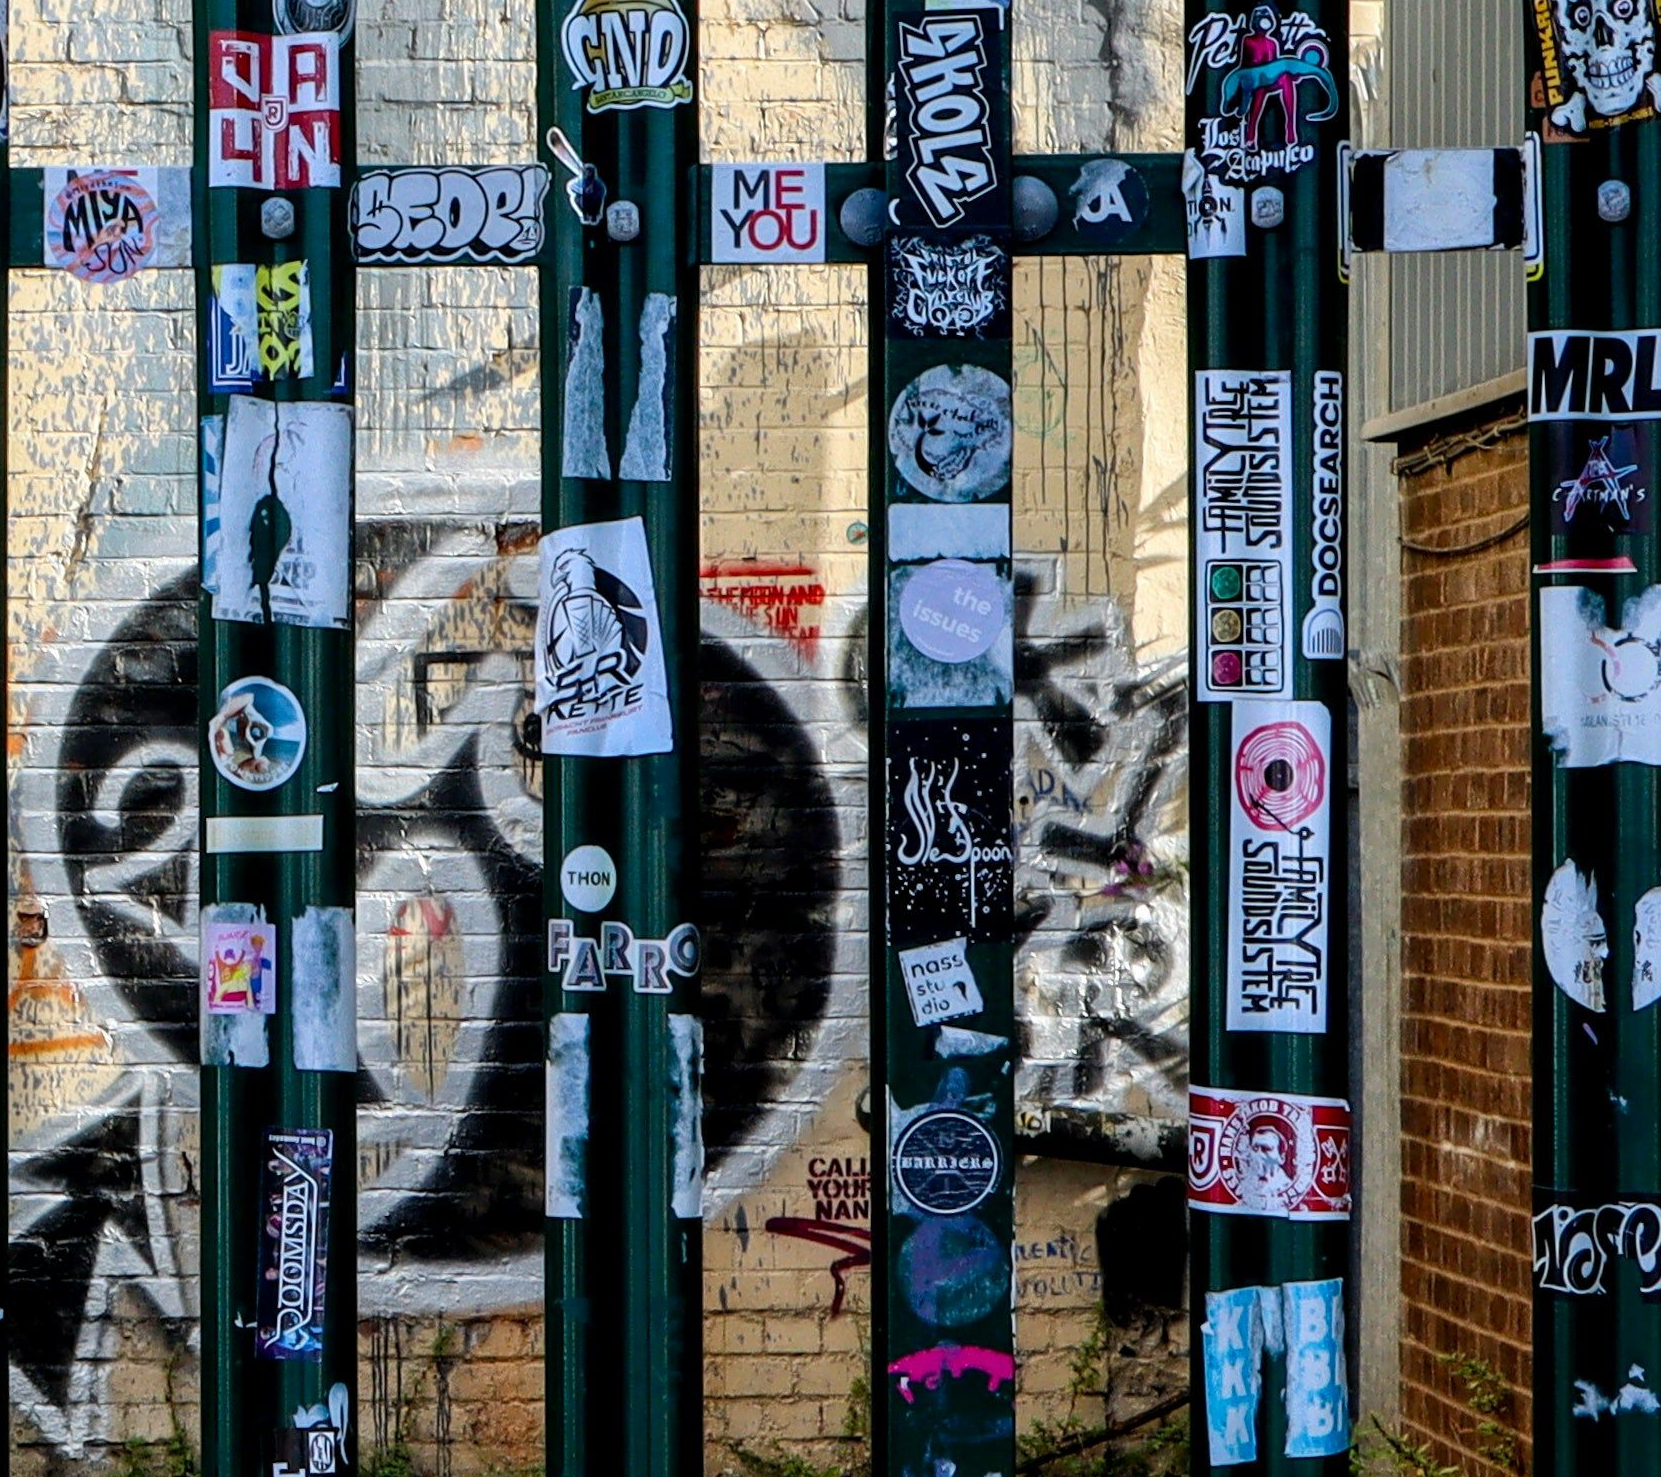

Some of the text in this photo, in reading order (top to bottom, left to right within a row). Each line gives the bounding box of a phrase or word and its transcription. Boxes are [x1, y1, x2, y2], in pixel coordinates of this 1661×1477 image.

[62, 189, 143, 252] MIYA
[1314, 372, 1343, 598] DOCSEARCH
[954, 583, 991, 617] the
[913, 600, 982, 645] issues
[566, 870, 612, 887] THON
[547, 918, 703, 995] FARRO
[910, 955, 964, 978] nass
[920, 996, 951, 1014] dio
